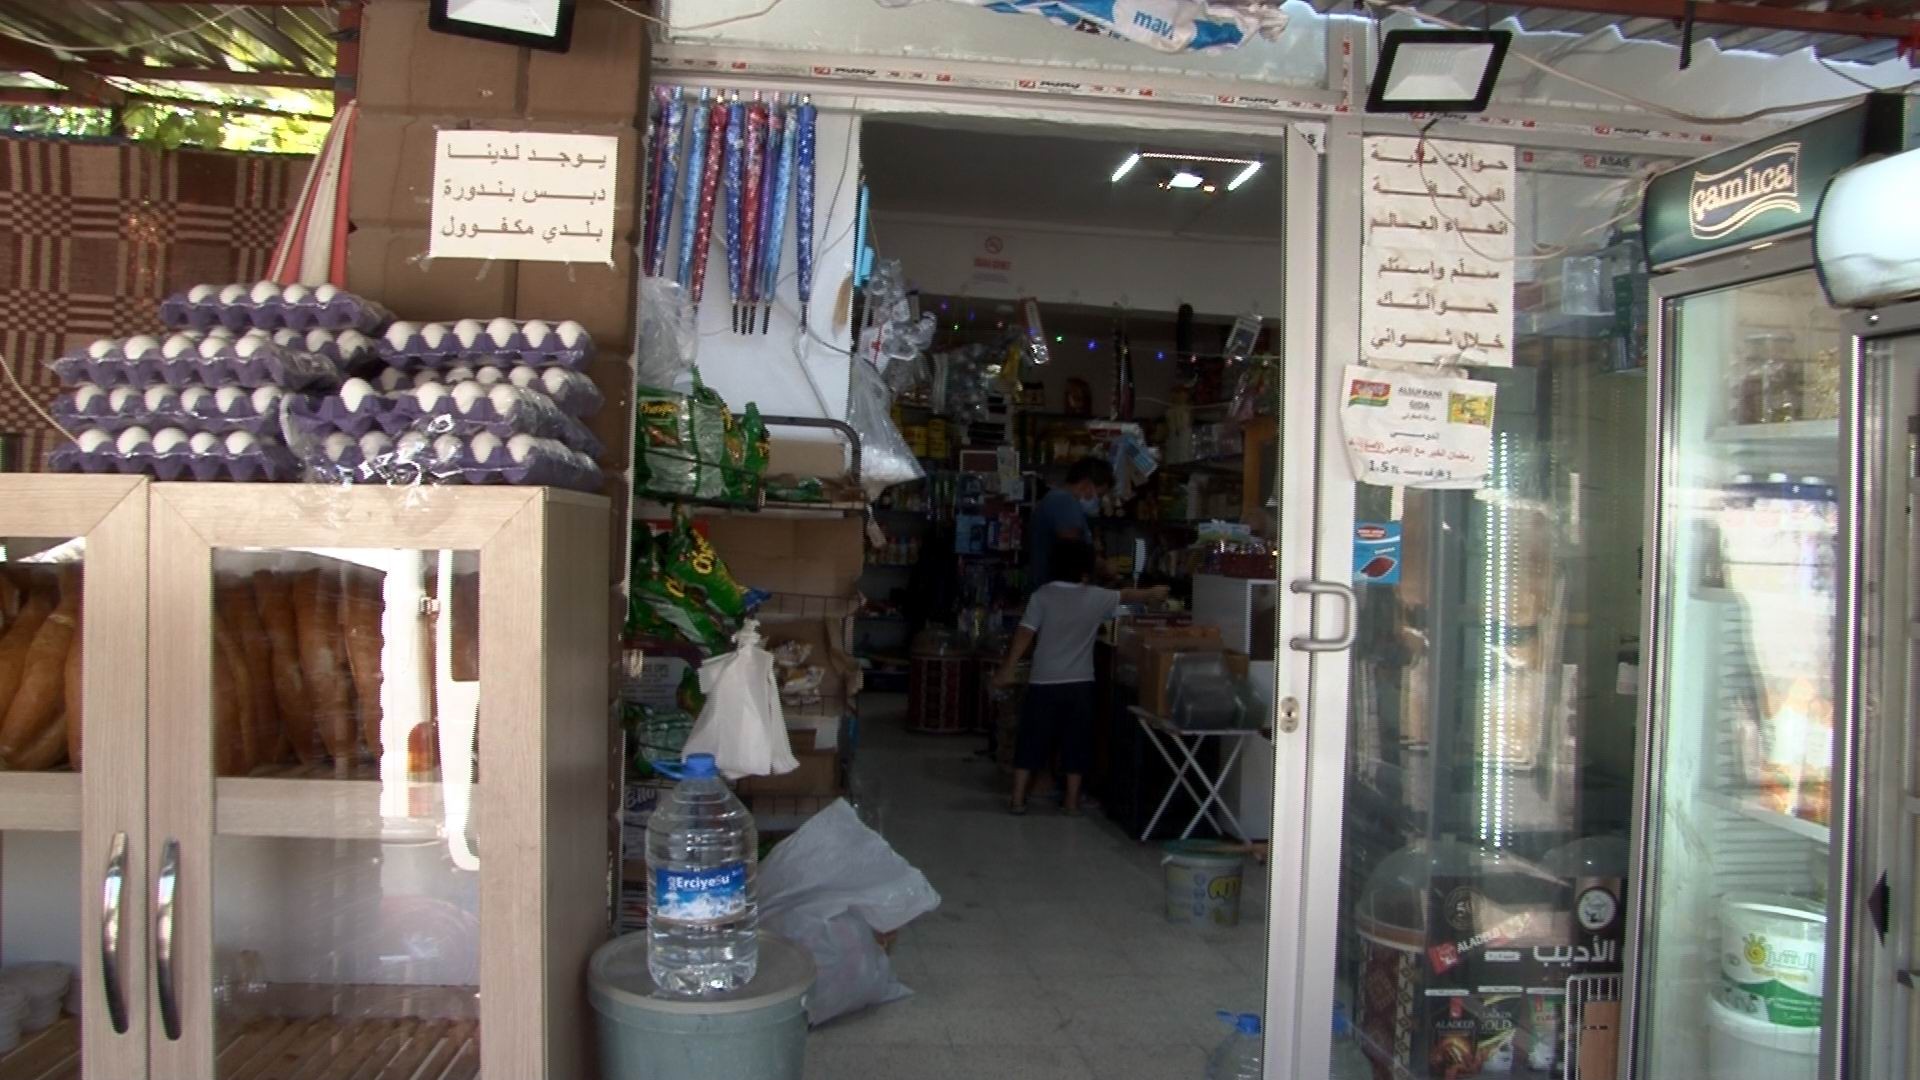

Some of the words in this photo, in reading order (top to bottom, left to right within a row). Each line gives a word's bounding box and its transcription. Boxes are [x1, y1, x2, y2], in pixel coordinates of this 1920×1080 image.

[1133, 9, 1174, 41] mavi
[448, 143, 520, 165] لدينا
[528, 149, 606, 169] يوجد
[1371, 143, 1438, 168] مية
[1446, 153, 1508, 172] حوالات
[443, 178, 516, 202] بندورة
[522, 188, 606, 205] دبس
[542, 220, 603, 243] بلدي
[1376, 291, 1498, 315] حوالتك
[1458, 331, 1505, 351] خلال
[1533, 937, 1615, 967] الأديب
